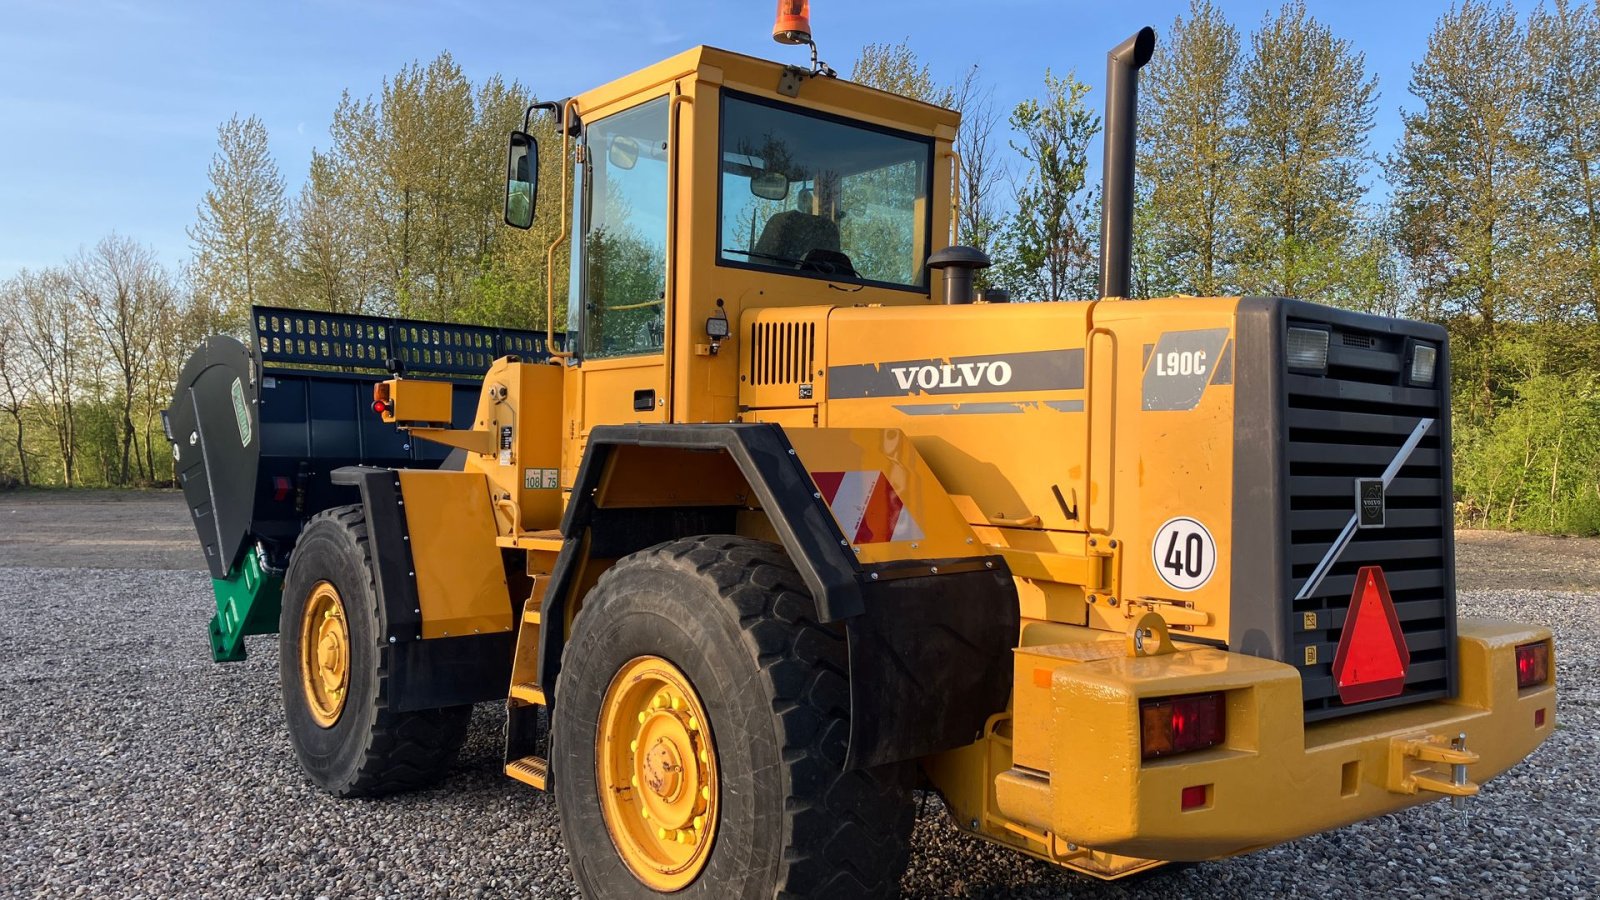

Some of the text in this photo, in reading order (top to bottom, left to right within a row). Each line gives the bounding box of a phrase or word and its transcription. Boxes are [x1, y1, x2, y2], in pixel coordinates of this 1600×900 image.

[891, 361, 1013, 390] VOLVO
[1156, 350, 1207, 376] L90C
[526, 477, 540, 488] 108
[548, 477, 557, 488] 75
[1164, 531, 1203, 578] 40
